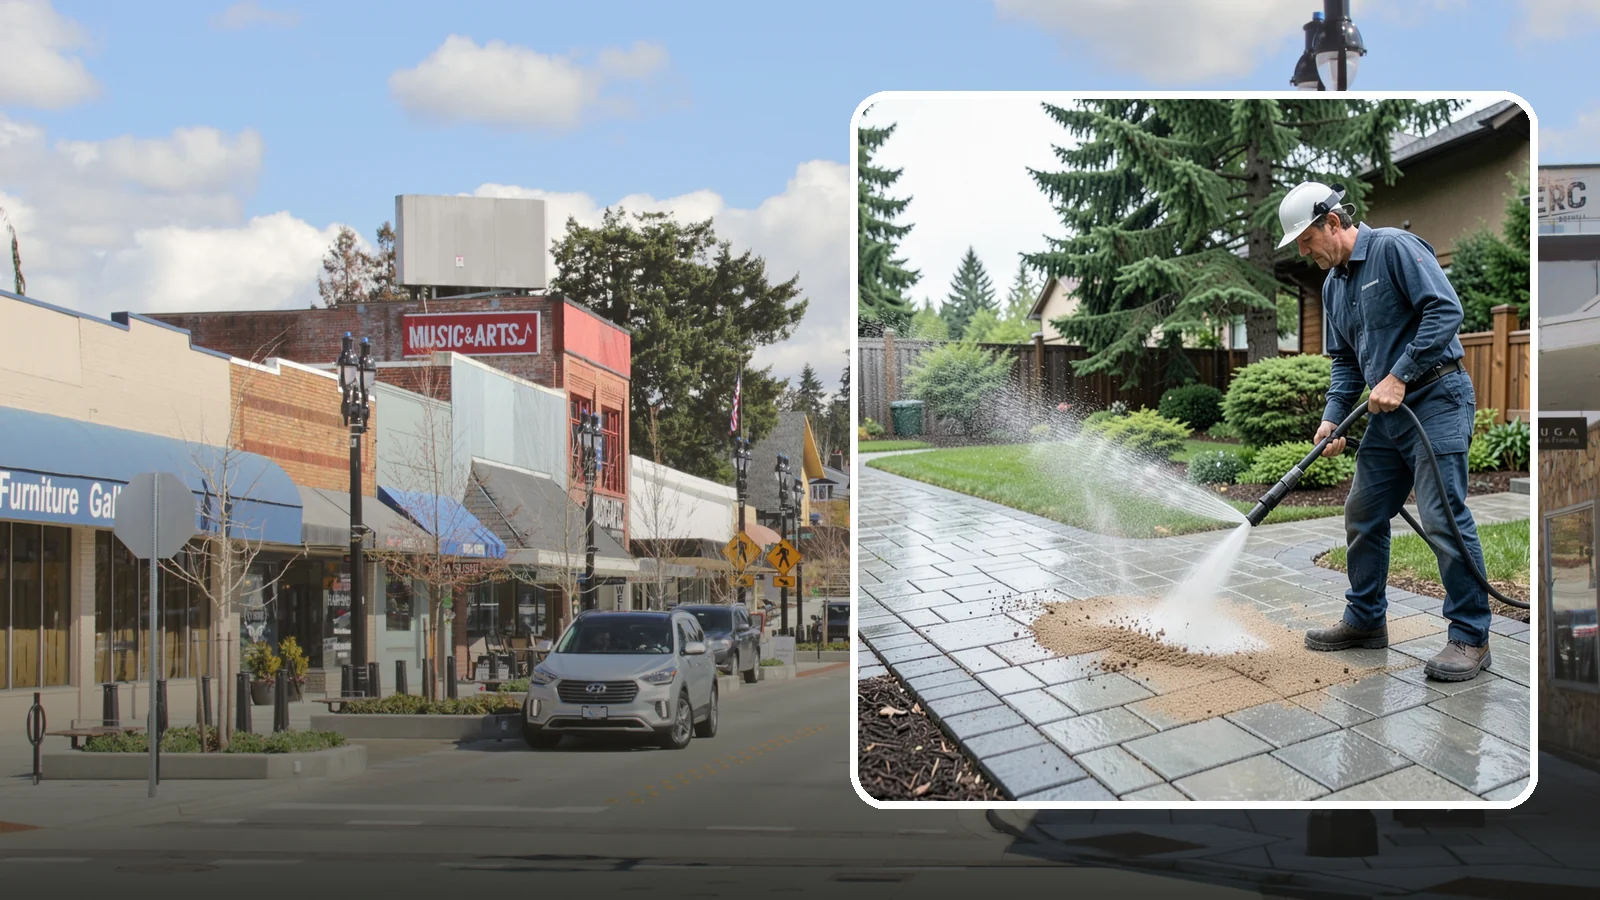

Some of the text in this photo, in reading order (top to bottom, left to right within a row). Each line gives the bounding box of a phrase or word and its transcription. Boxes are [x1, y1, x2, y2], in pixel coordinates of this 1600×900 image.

[1540, 428, 1577, 436] UGA
[0, 472, 79, 515] Furniture
[453, 563, 479, 574] SUSHI
